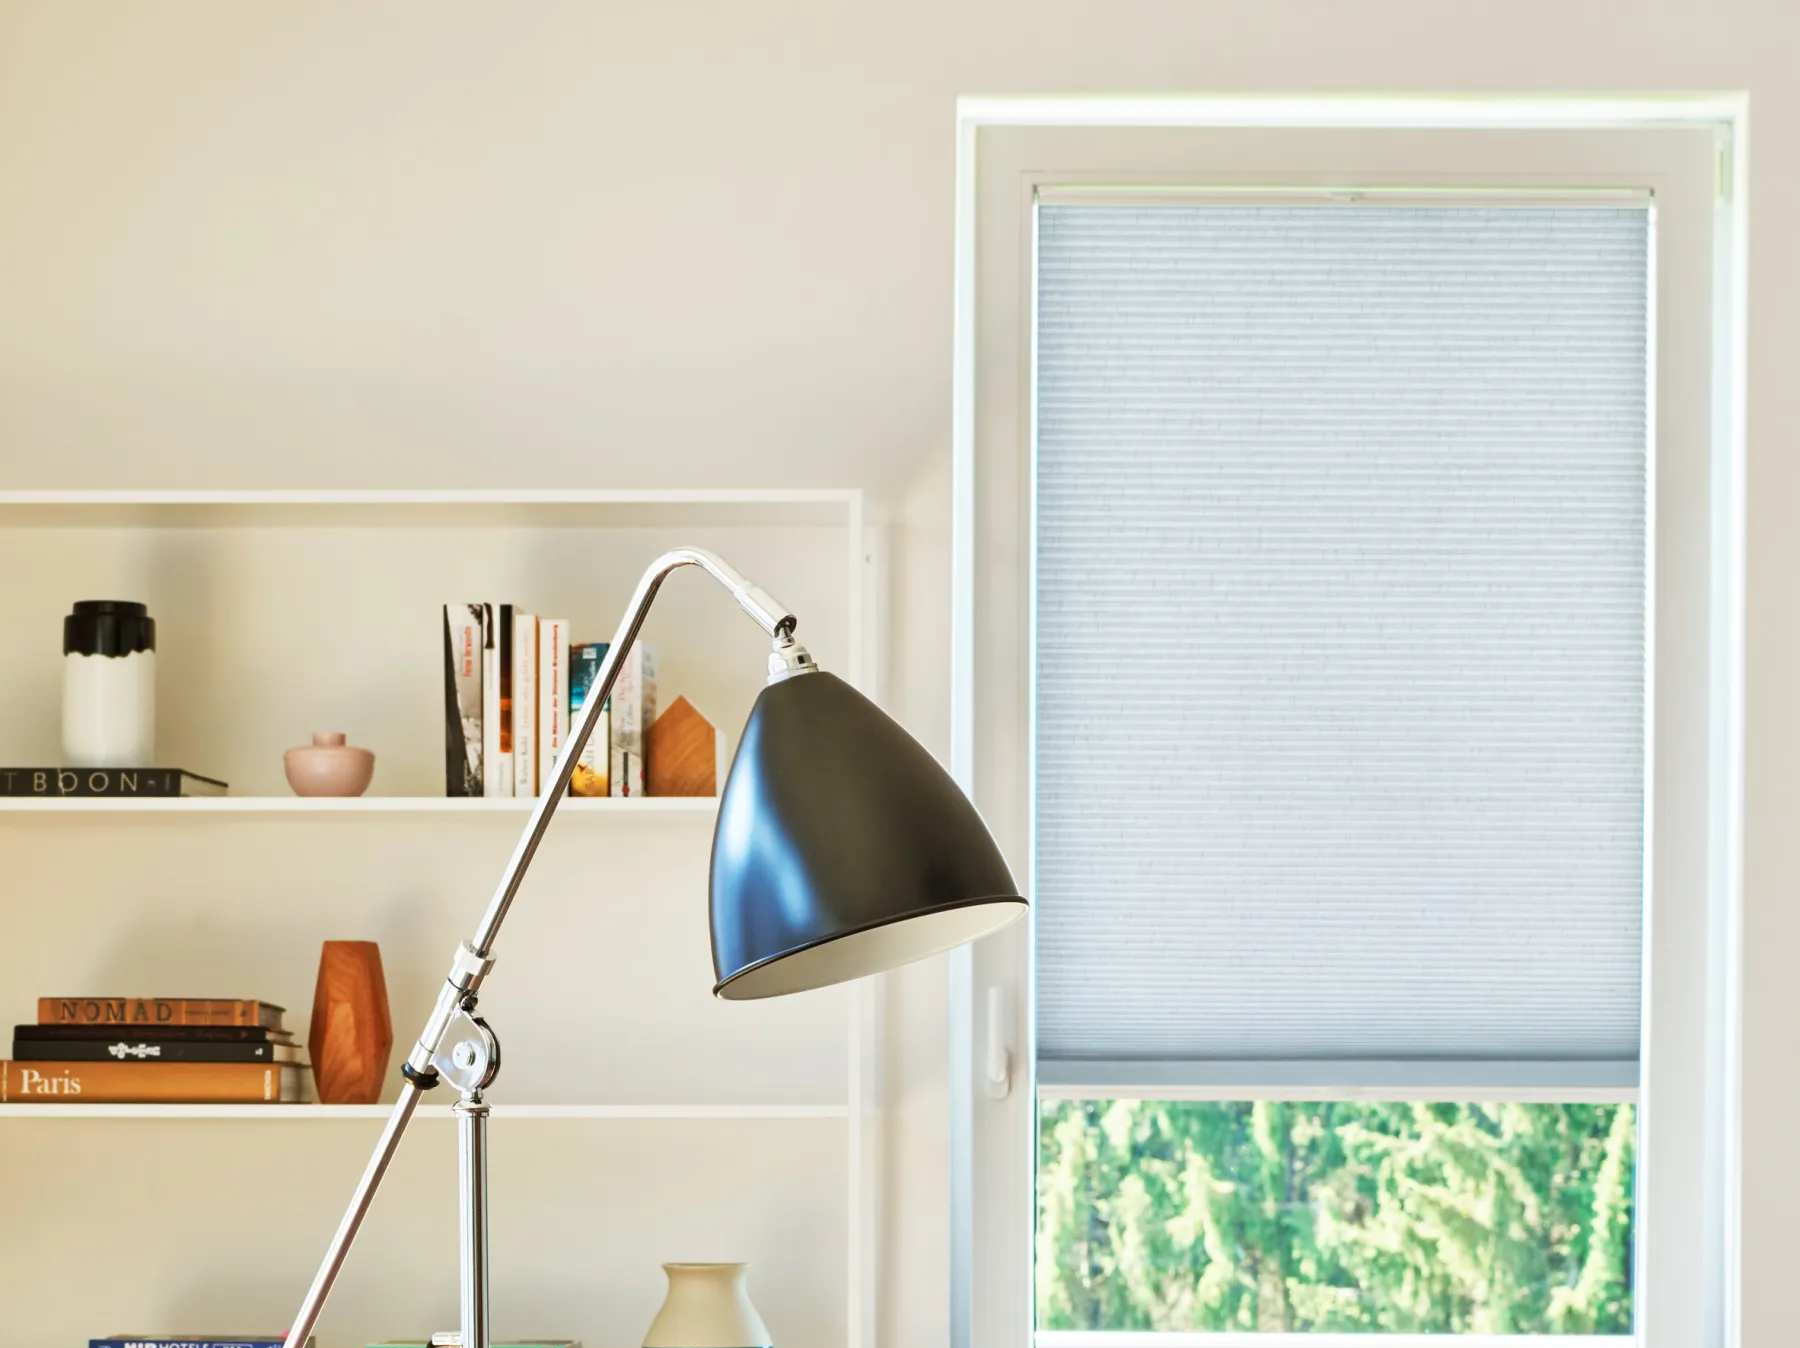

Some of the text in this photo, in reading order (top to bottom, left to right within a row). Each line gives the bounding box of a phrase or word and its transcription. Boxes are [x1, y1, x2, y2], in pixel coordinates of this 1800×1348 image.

[33, 772, 137, 792] BOON
[61, 1001, 173, 1022] NOMAD
[20, 1069, 82, 1095] Paris
